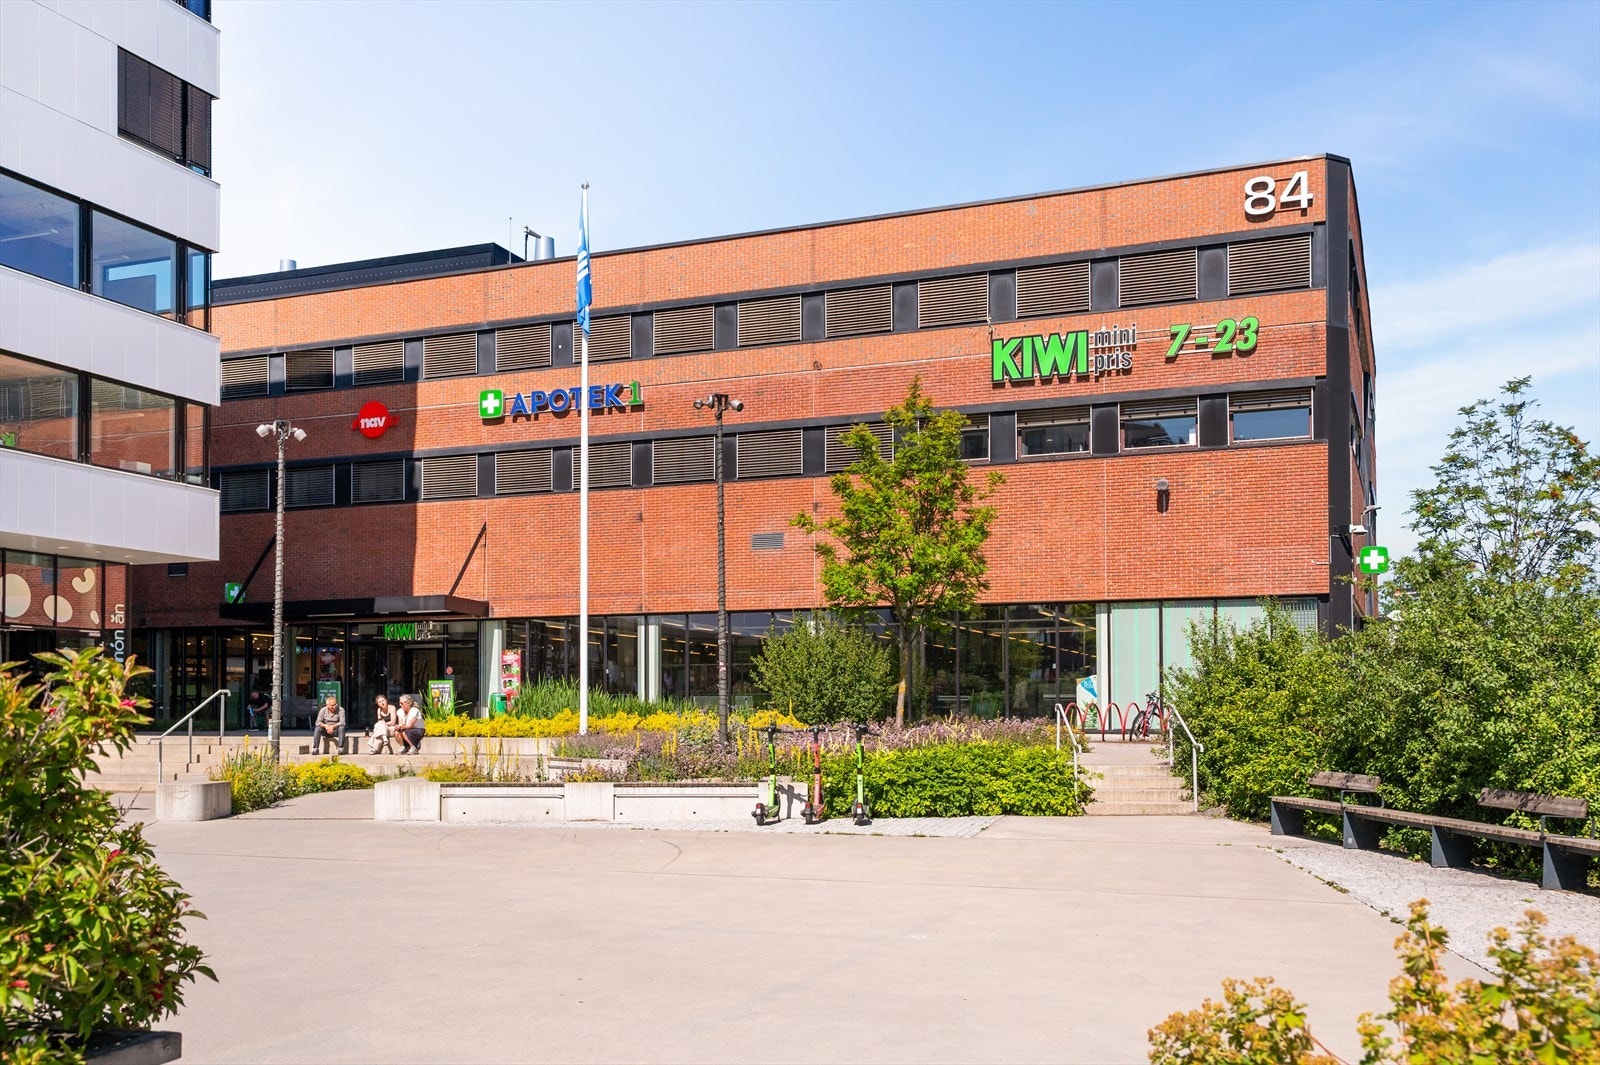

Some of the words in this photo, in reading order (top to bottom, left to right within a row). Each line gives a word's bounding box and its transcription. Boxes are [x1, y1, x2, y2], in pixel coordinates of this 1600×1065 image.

[1244, 171, 1313, 215] 84
[1094, 323, 1136, 347] mini
[992, 330, 1089, 381] KIWI
[1094, 348, 1132, 375] pris
[510, 383, 626, 415] APOTEK
[360, 416, 386, 429] nav
[384, 623, 416, 640] KIWI
